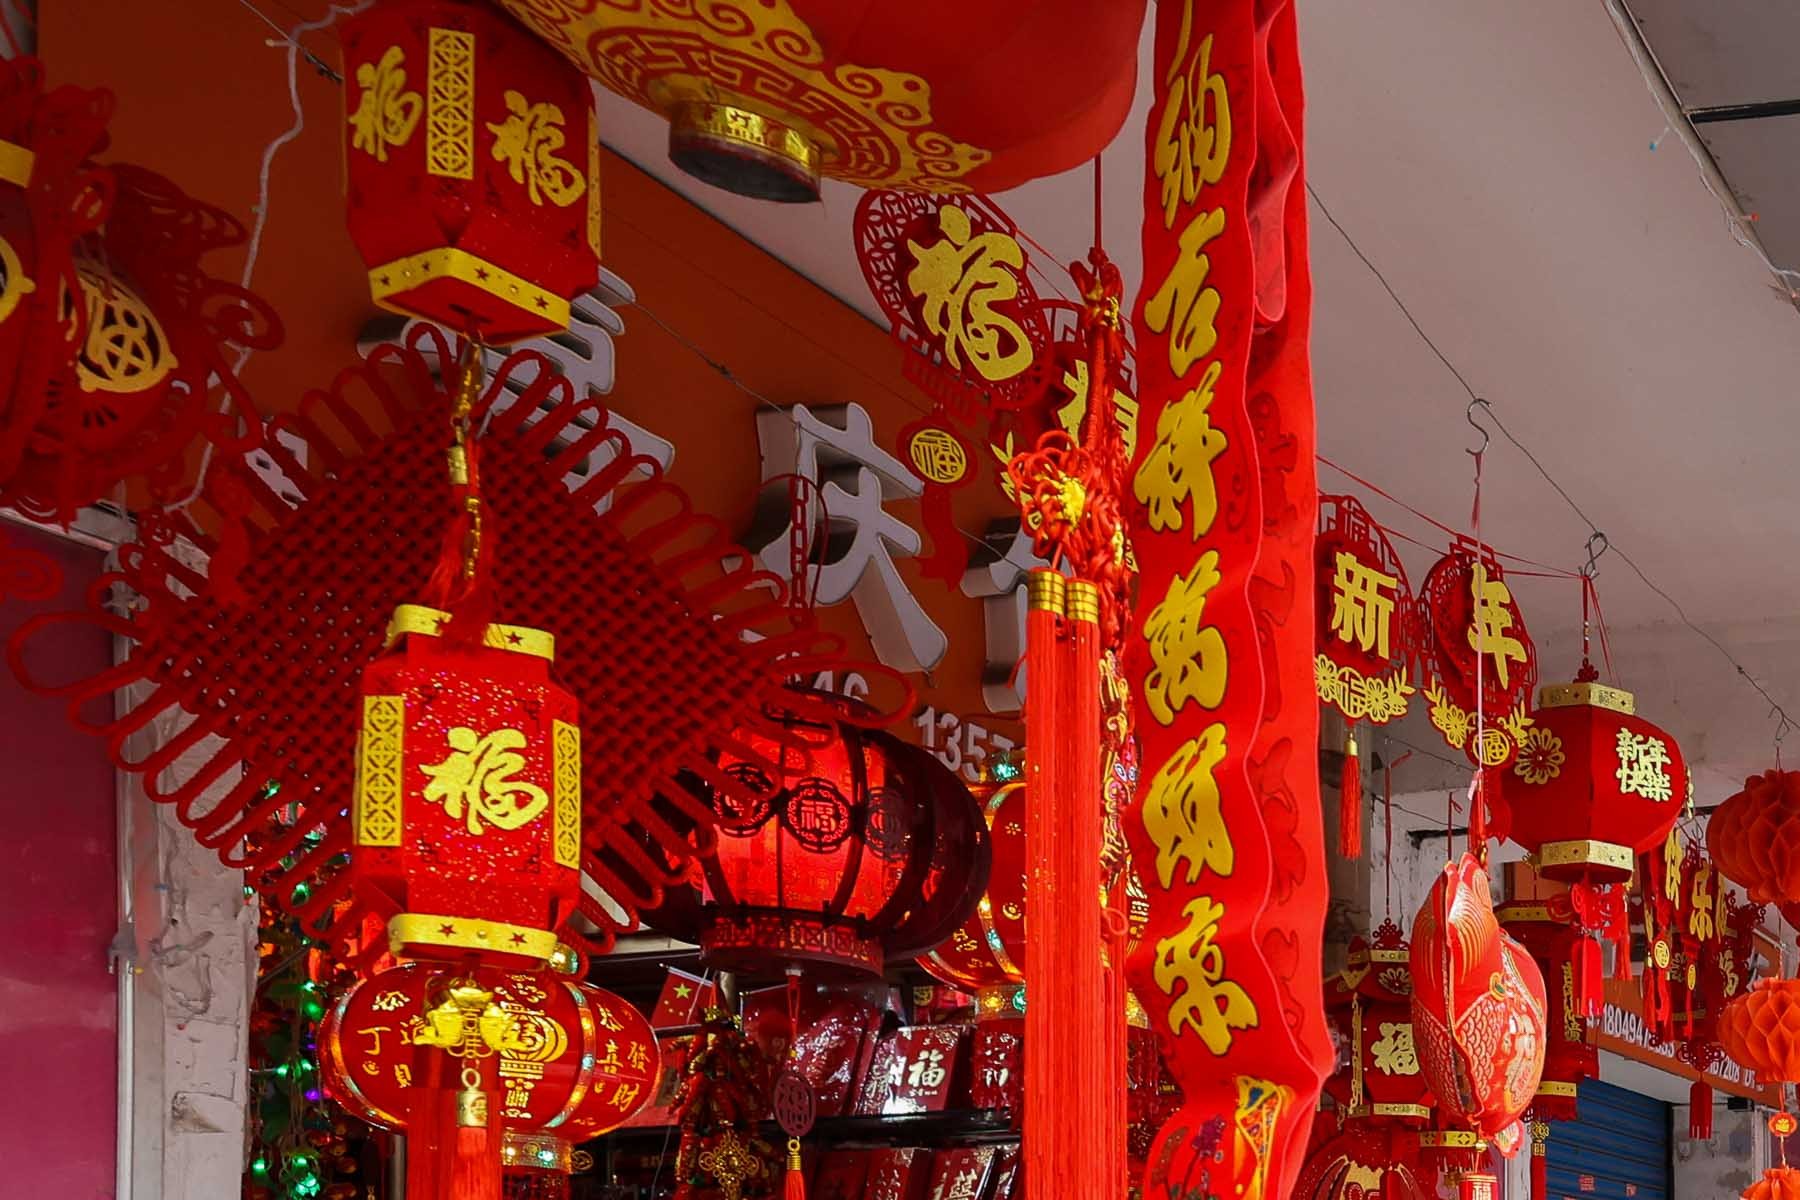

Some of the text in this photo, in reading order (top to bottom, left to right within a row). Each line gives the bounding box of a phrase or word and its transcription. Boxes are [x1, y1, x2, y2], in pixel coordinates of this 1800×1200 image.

[349, 46, 423, 162] 福
[486, 90, 587, 207] 福
[908, 205, 1033, 381] 福
[1331, 551, 1397, 660] 新
[1467, 562, 1528, 690] 年
[420, 726, 548, 835] 福
